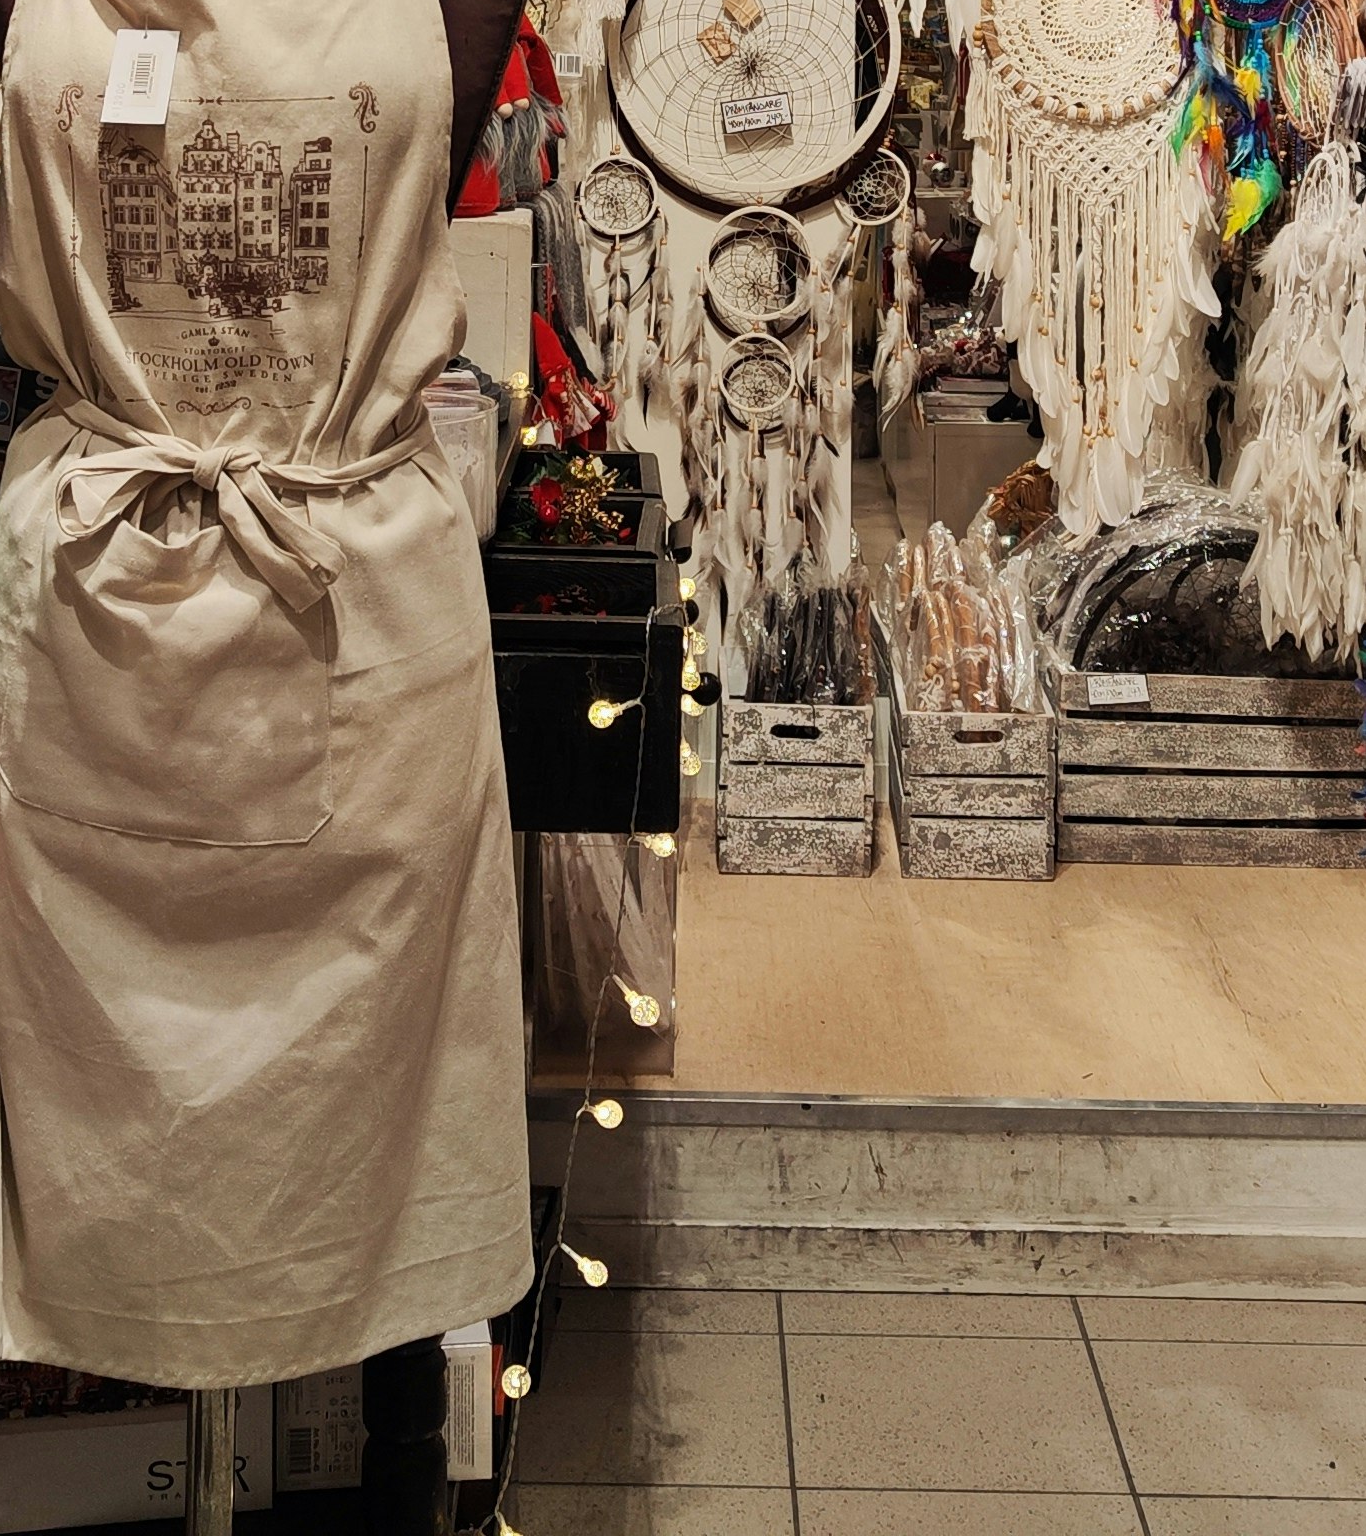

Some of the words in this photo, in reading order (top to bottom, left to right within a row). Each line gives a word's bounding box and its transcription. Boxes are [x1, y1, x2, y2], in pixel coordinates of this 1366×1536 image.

[181, 326, 217, 340] GAMLA
[221, 326, 251, 339] STAN
[184, 345, 247, 357] STORTORGET
[124, 350, 220, 373] STOCKHOLM
[224, 353, 262, 370] OLD
[266, 352, 315, 372] TOWN
[145, 367, 212, 384] SVERIGE
[222, 369, 293, 383] SWEDEN
